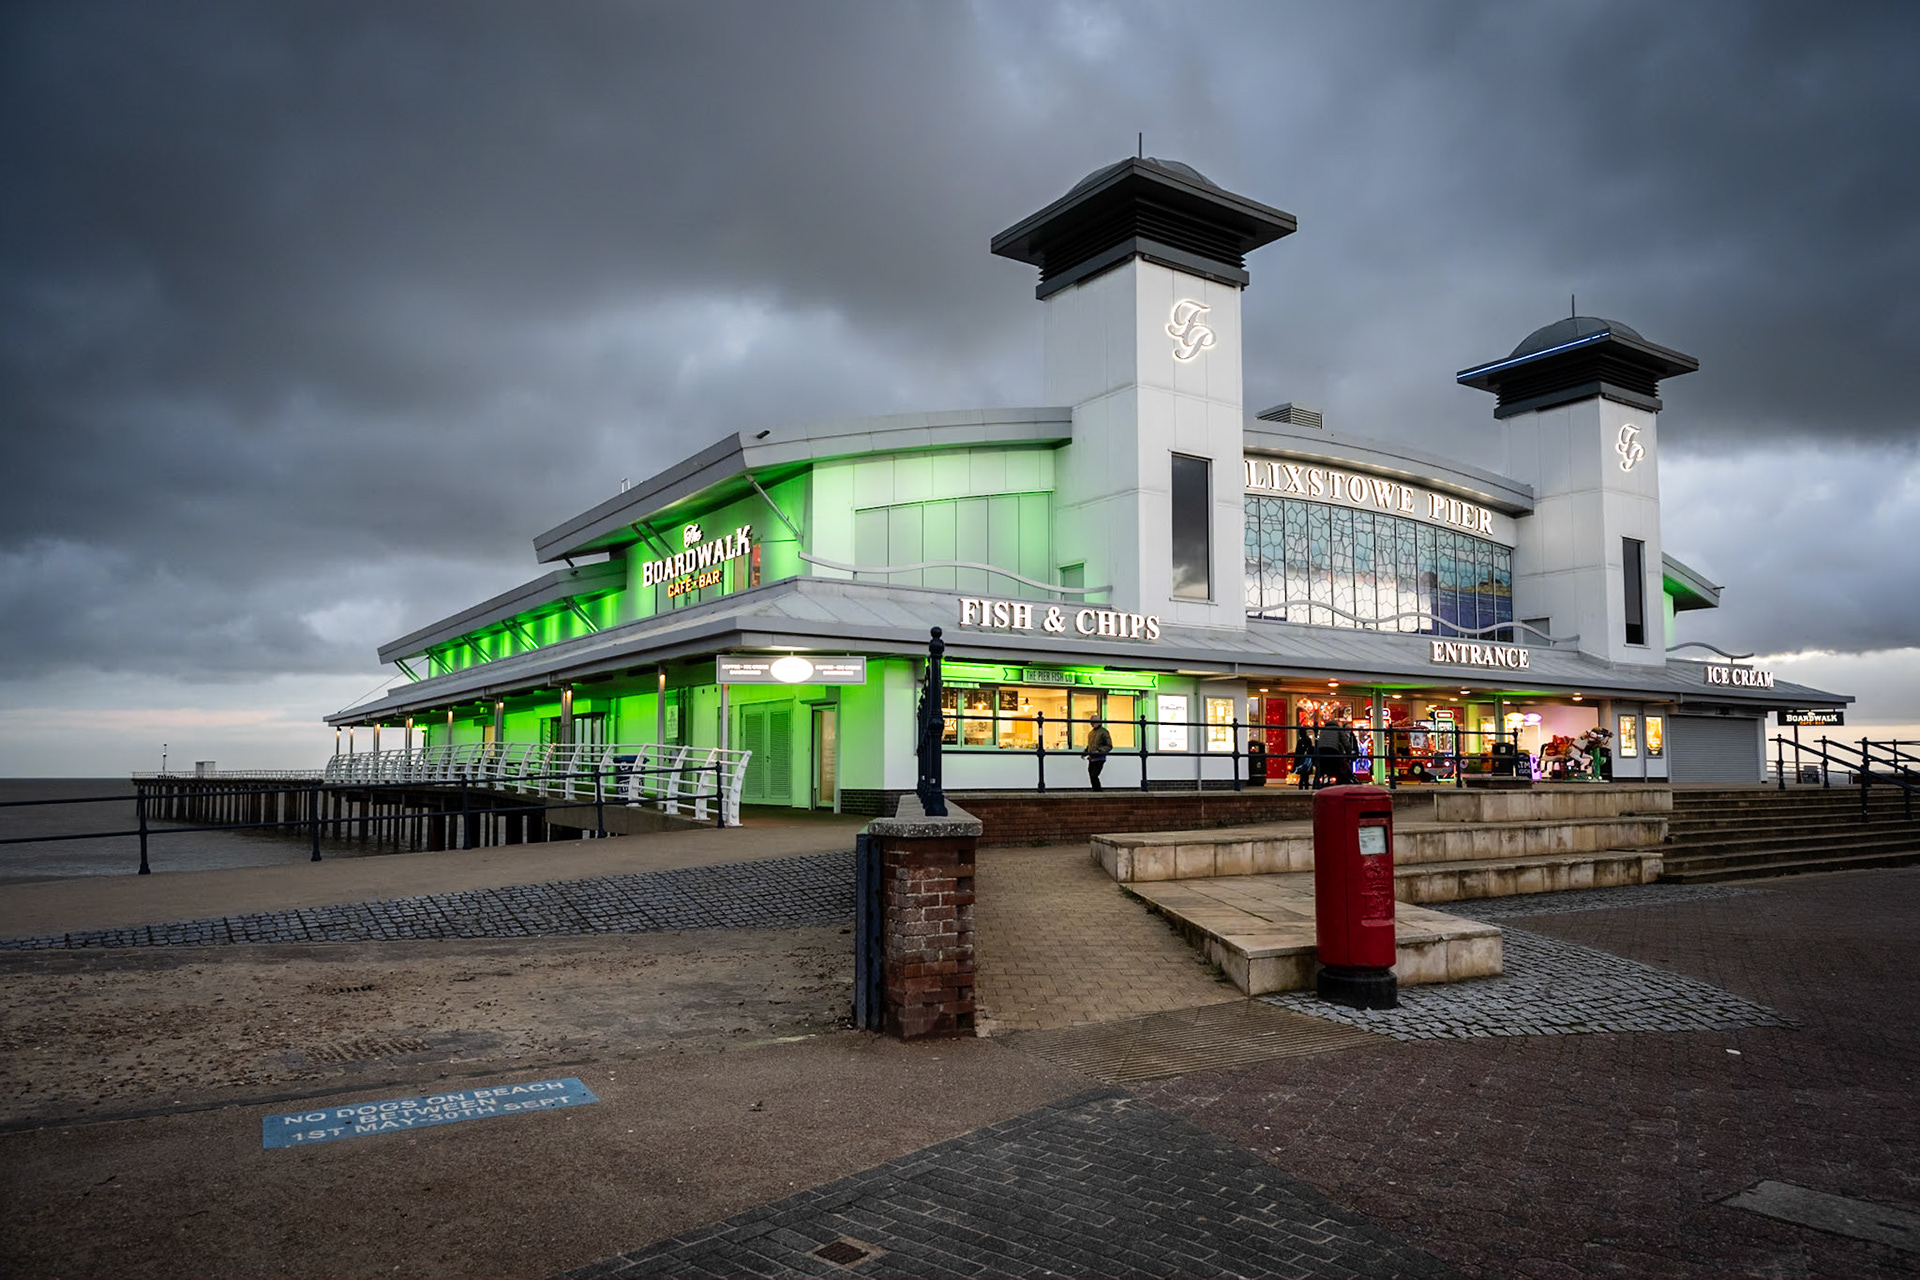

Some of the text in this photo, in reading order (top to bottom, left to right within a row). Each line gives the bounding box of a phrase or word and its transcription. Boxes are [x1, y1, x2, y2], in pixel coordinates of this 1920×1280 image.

[1243, 459, 1495, 536] LIXSTOWE PIER
[683, 524, 702, 547] The
[642, 524, 753, 587] BOARDWALK
[698, 569, 722, 589] BAR
[959, 598, 1161, 640] FISH & CHIPS
[1431, 641, 1531, 669] ENTRANCE
[1026, 671, 1036, 680] THE
[1038, 671, 1050, 681] PIER
[1051, 671, 1064, 682] FISH
[1707, 666, 1774, 687] ICE CREAM
[1786, 714, 1838, 722] BOARDWALK
[284, 1082, 566, 1126] NO DOGS ON BEACH
[360, 1098, 498, 1125] BETWEEN
[292, 1126, 345, 1142] 1ST
[504, 1096, 571, 1112] SEPT
